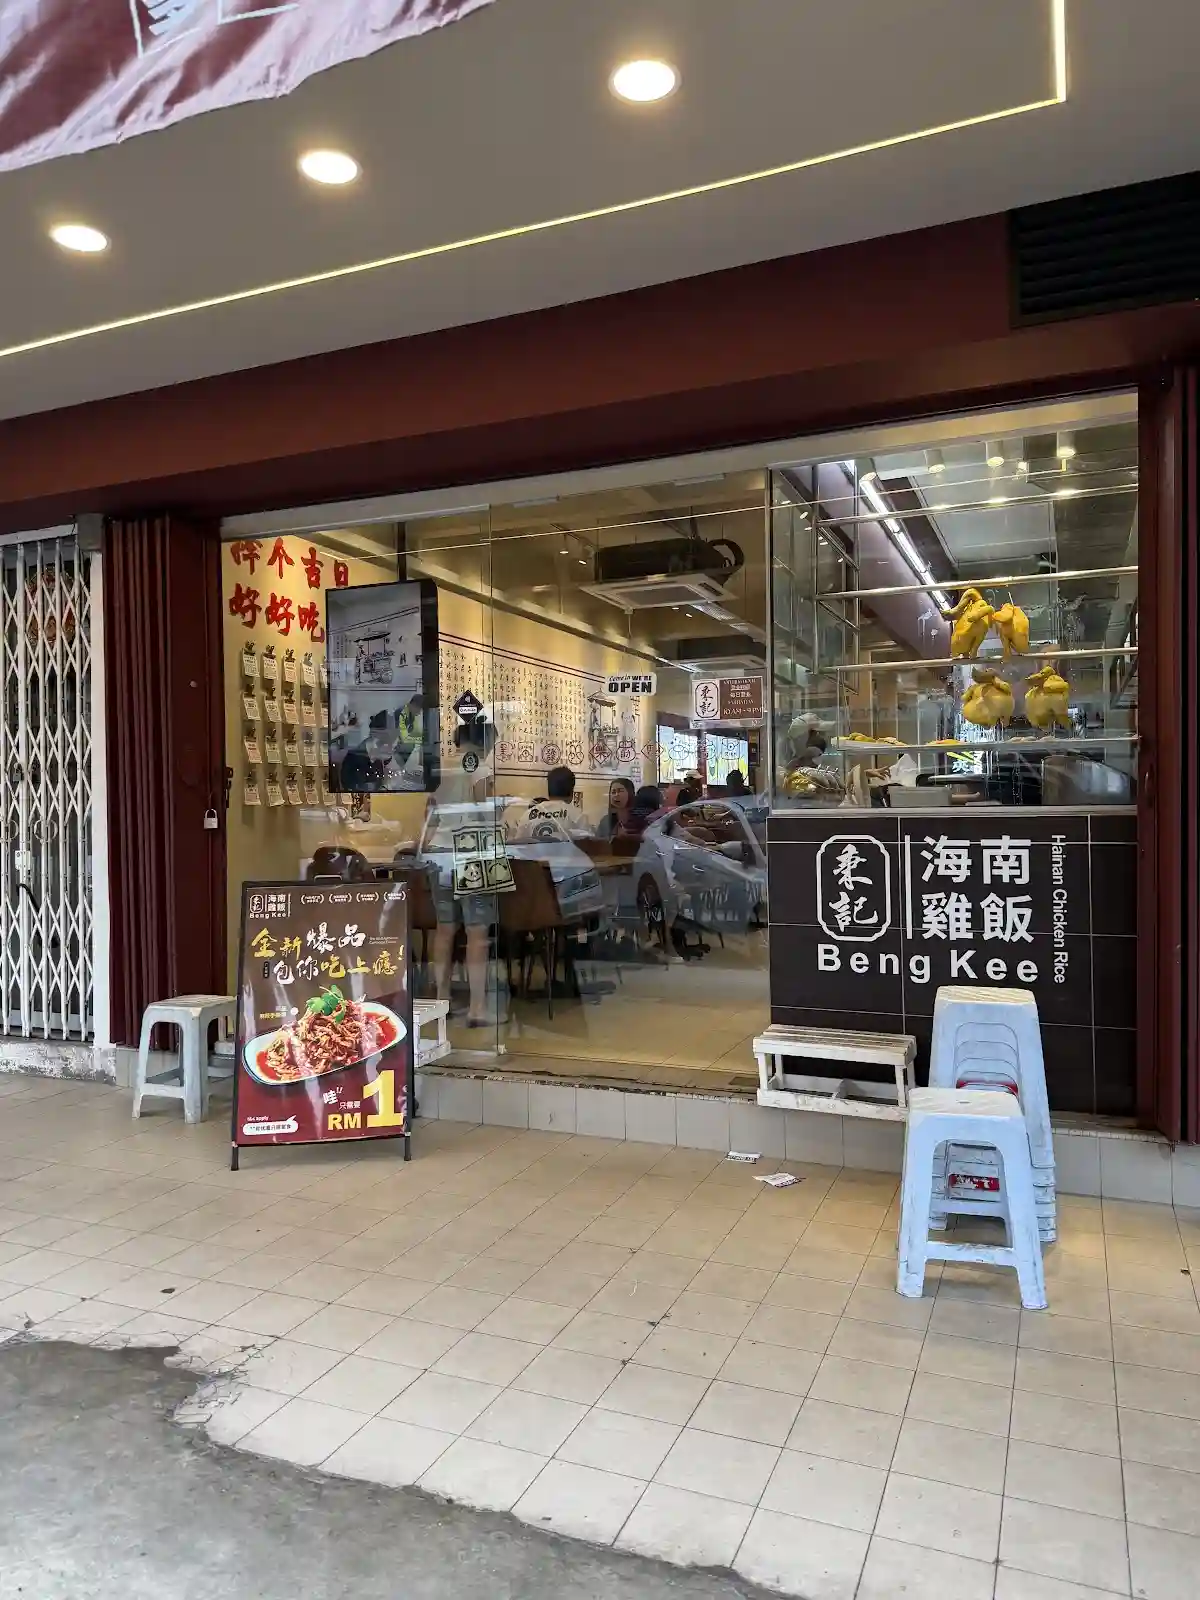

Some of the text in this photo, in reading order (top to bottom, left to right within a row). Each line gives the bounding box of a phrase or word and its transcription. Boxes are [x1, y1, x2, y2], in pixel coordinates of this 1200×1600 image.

[228, 582, 325, 643] 好好吃
[608, 681, 652, 693] OPEN
[920, 835, 1032, 885] 海南
[921, 891, 1035, 943] 雞飯
[1051, 834, 1069, 984] Hainan Chicken Rice
[251, 922, 366, 961] 全新爆品
[817, 943, 1039, 984] Beng Kee
[327, 1069, 404, 1130] RM 1
